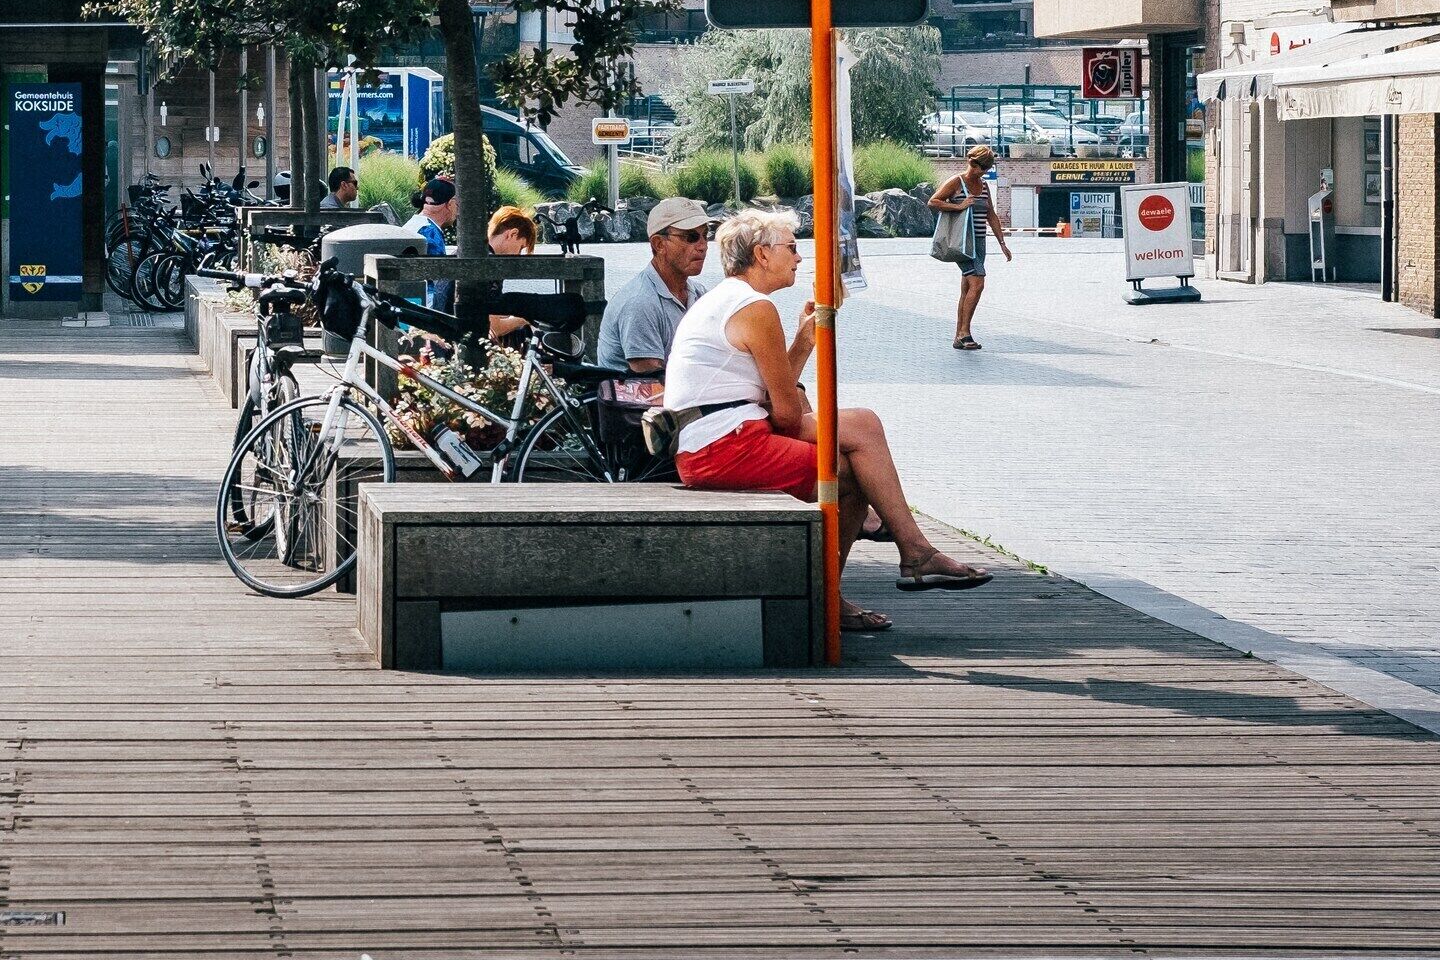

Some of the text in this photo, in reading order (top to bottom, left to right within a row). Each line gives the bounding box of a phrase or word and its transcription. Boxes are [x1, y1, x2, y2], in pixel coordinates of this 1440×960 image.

[1121, 51, 1134, 95] Jupiler
[14, 91, 74, 100] Gemeentehuis
[15, 100, 74, 112] KOKSIJDE
[1052, 162, 1079, 170] GARAGES
[1081, 162, 1088, 170] TE
[1089, 162, 1105, 170] HUUR
[1114, 162, 1134, 170] LOUER
[1083, 194, 1111, 204] UITRIT
[1140, 207, 1172, 217] dewaele
[1134, 249, 1184, 261] welkom
